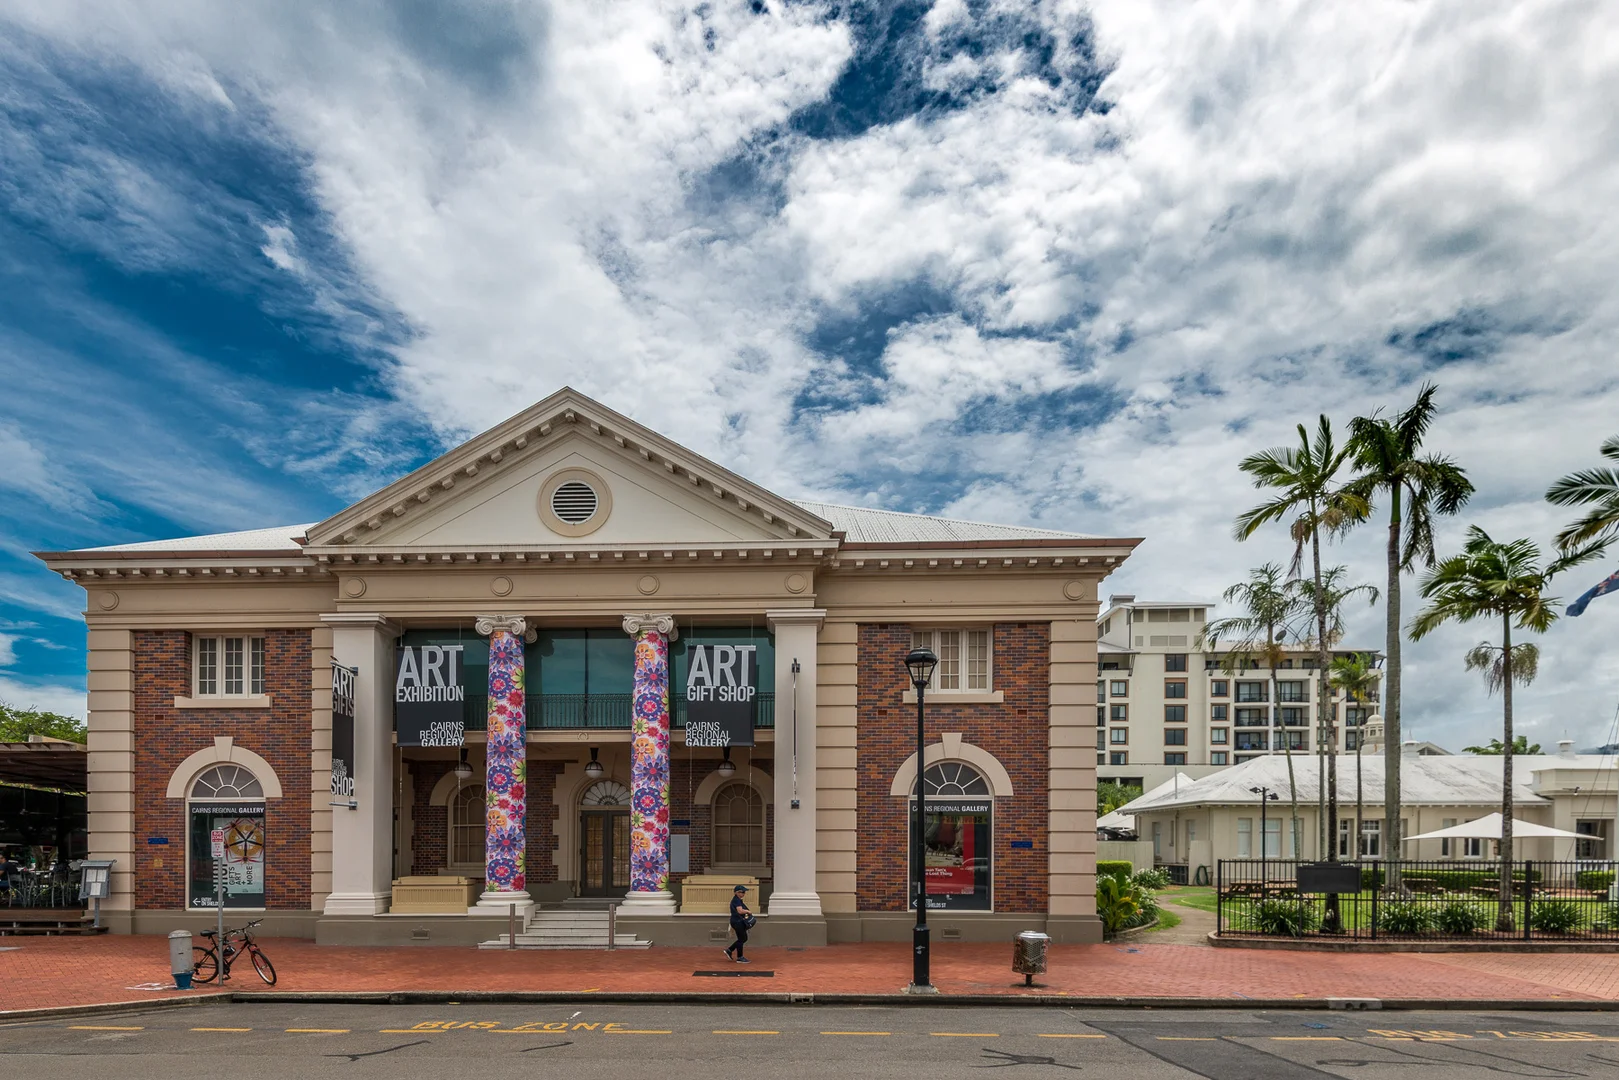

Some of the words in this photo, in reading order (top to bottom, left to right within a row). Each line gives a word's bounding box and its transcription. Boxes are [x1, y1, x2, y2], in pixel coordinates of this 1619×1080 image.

[396, 645, 464, 687] ART
[687, 645, 756, 687] ART
[332, 666, 354, 699] ART
[396, 686, 464, 702] EXHIBITION
[687, 685, 716, 702] GIFT
[719, 685, 755, 702] SHOP
[332, 691, 354, 718] GIFTS
[430, 721, 464, 731] CAIRNS
[685, 721, 720, 731] CAIRNS
[419, 730, 464, 740] REGIONAL
[685, 730, 730, 739] REGIONAL
[421, 738, 465, 747] GALLERY
[685, 738, 731, 747] GALLERY
[331, 775, 355, 796] SHOP
[411, 1021, 501, 1030] BUS
[513, 1021, 629, 1031] ZONE
